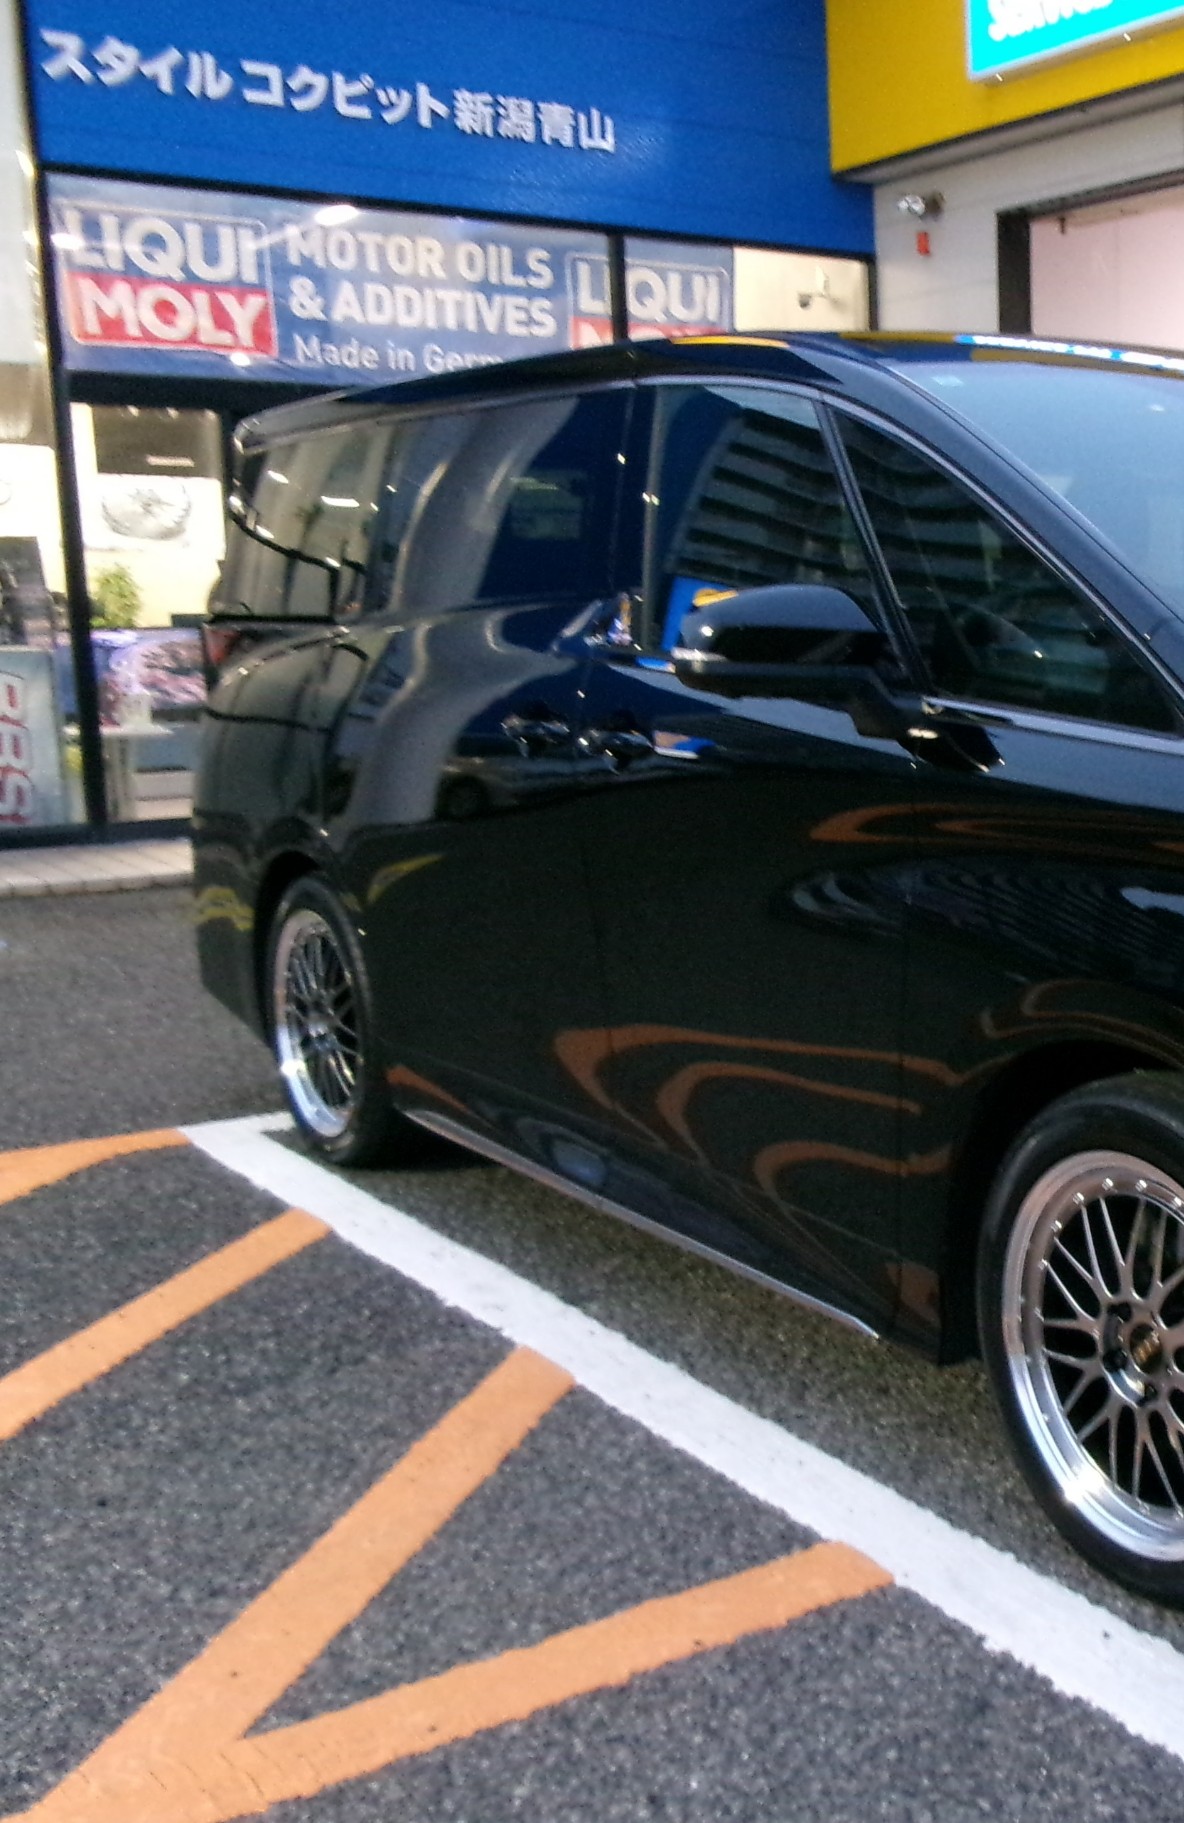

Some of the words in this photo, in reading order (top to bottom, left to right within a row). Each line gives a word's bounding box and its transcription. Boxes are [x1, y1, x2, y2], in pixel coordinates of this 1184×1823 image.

[40, 27, 234, 101] スタイル
[240, 57, 615, 153] コクピット新潟青山
[66, 209, 259, 284] LIQUI
[284, 222, 447, 282] MOTOR
[456, 240, 555, 290] OILS
[78, 276, 267, 348] MOLY
[288, 273, 329, 322] &
[329, 280, 557, 338] ADDITIVES
[292, 333, 381, 371] Made
[386, 338, 417, 372] in
